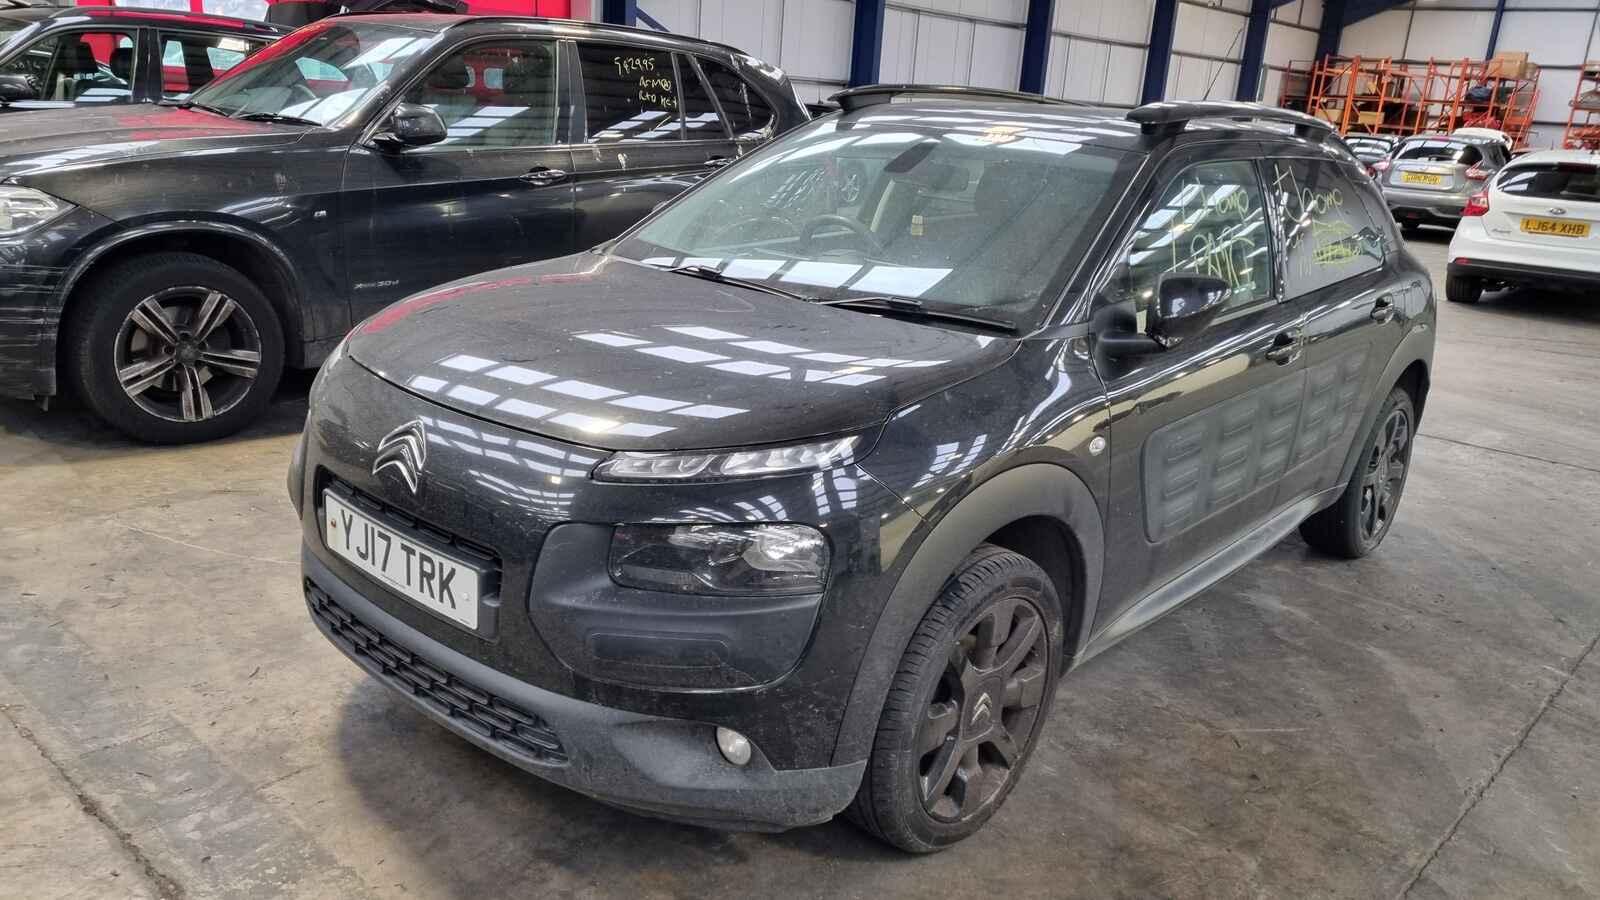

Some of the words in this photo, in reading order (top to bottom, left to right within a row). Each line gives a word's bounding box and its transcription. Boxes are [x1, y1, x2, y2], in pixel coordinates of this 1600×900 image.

[1524, 218, 1556, 233] LJ64
[1559, 222, 1586, 235] XHB
[341, 509, 392, 573] YJ17
[400, 543, 457, 610] TRK
